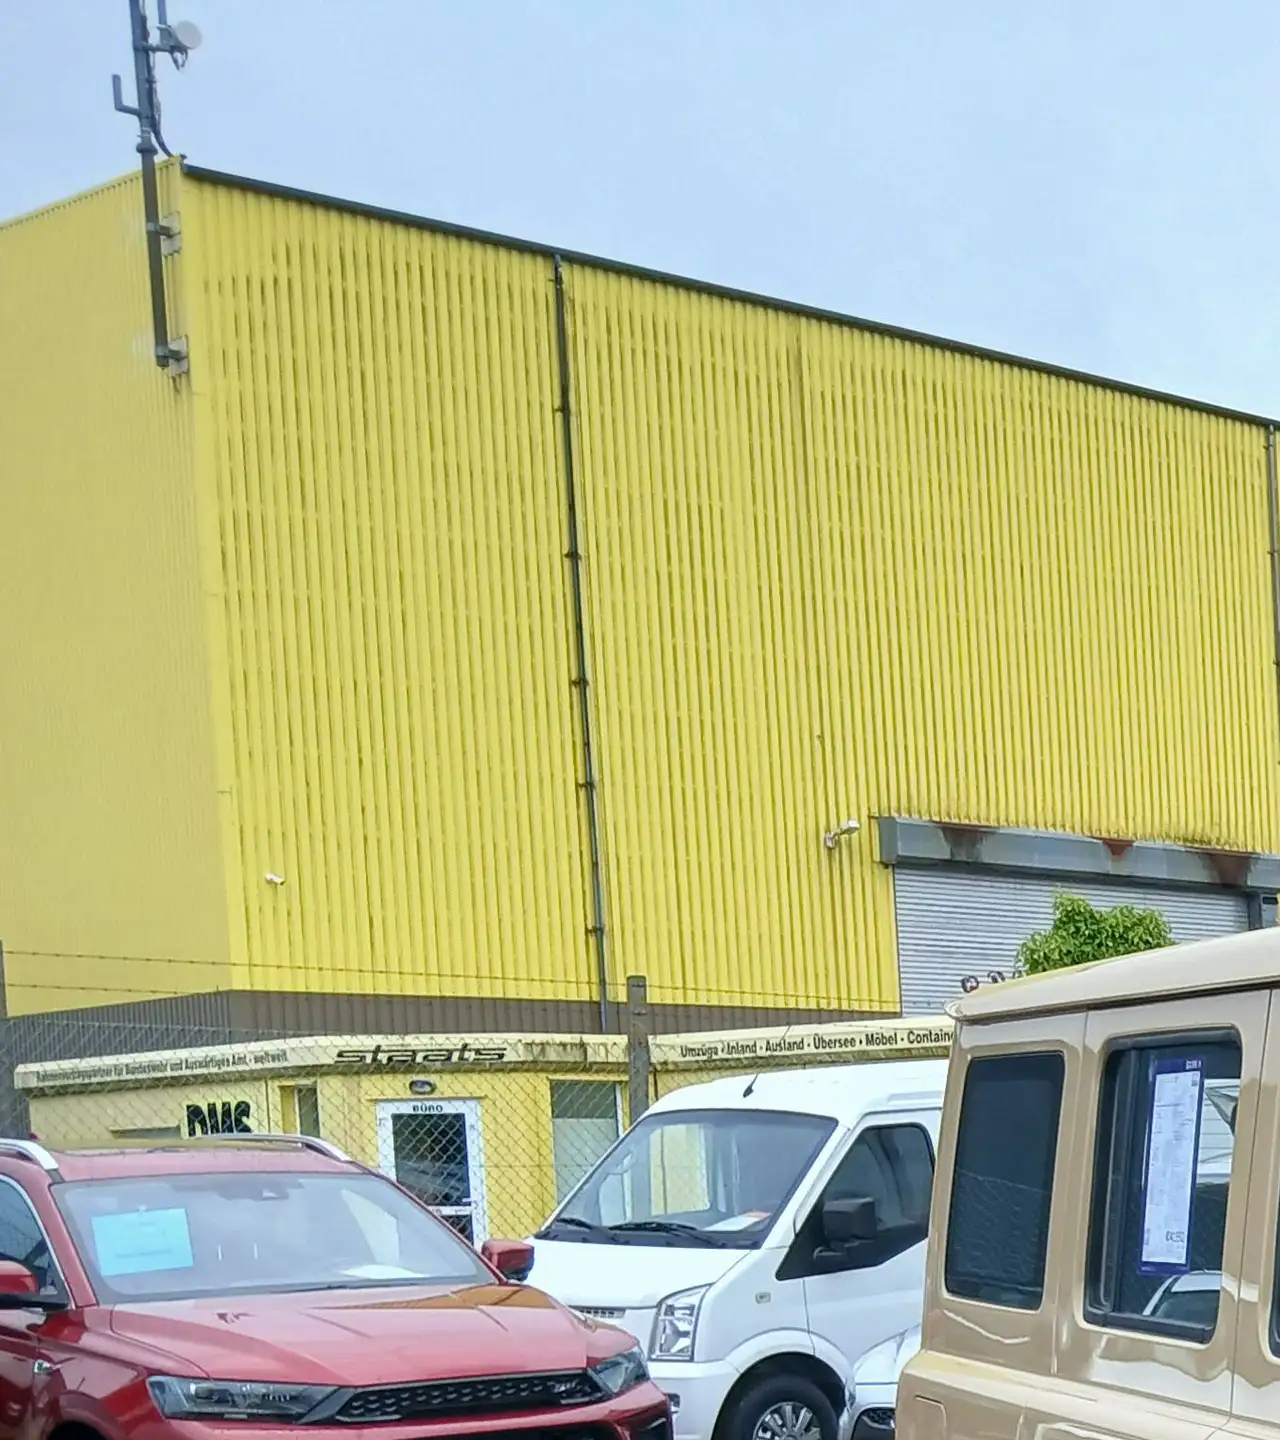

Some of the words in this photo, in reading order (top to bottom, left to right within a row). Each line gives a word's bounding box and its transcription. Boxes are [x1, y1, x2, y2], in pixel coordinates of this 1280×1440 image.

[765, 1038, 805, 1053] Ausland
[813, 1032, 857, 1050] Übersee
[865, 1030, 898, 1047] Möbel
